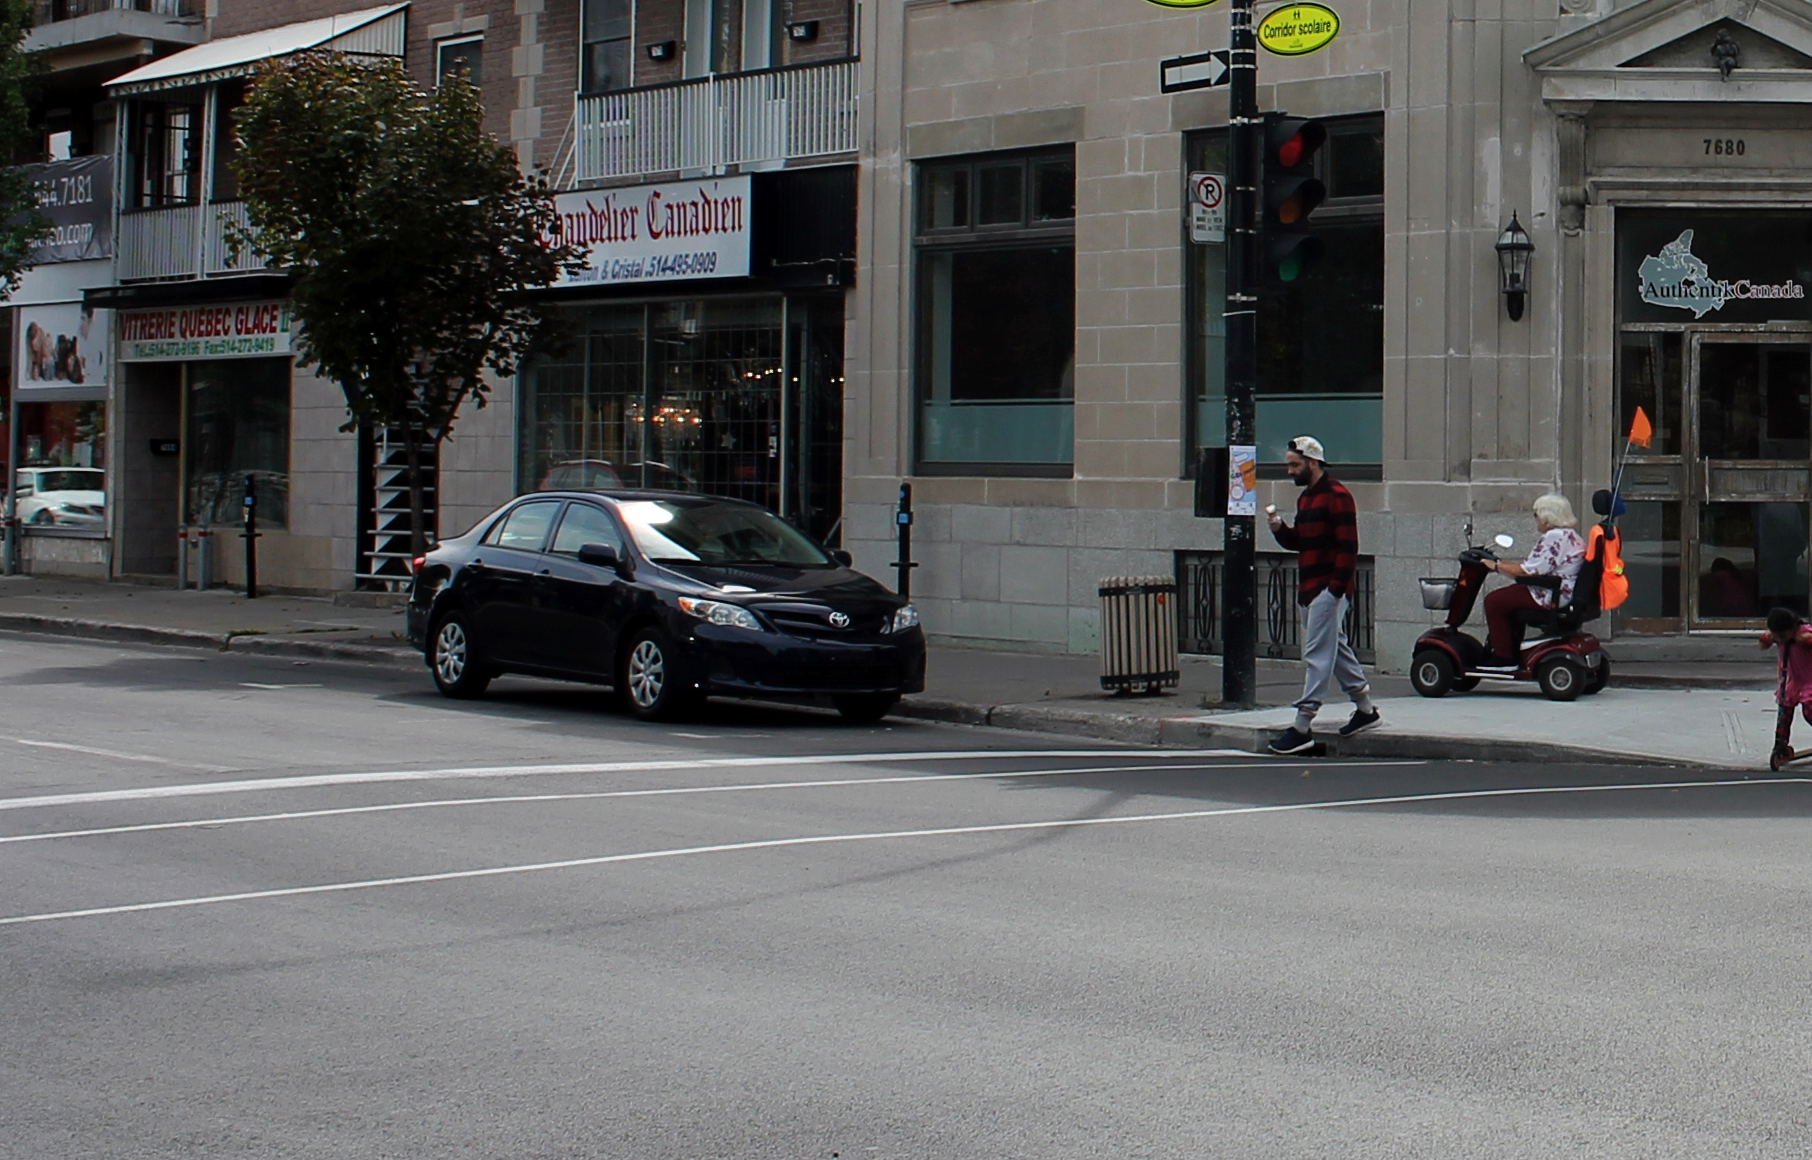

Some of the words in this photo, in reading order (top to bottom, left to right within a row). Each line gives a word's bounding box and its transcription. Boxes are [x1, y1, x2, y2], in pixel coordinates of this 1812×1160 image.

[1264, 22, 1297, 39] Corridor
[1298, 18, 1331, 35] scolaire
[1703, 139, 1746, 156] 7680
[646, 182, 743, 240] Canadien
[601, 259, 608, 280] &
[611, 257, 645, 280] Cristal
[120, 310, 176, 340] VITRERIE
[235, 304, 279, 336] GLACE
